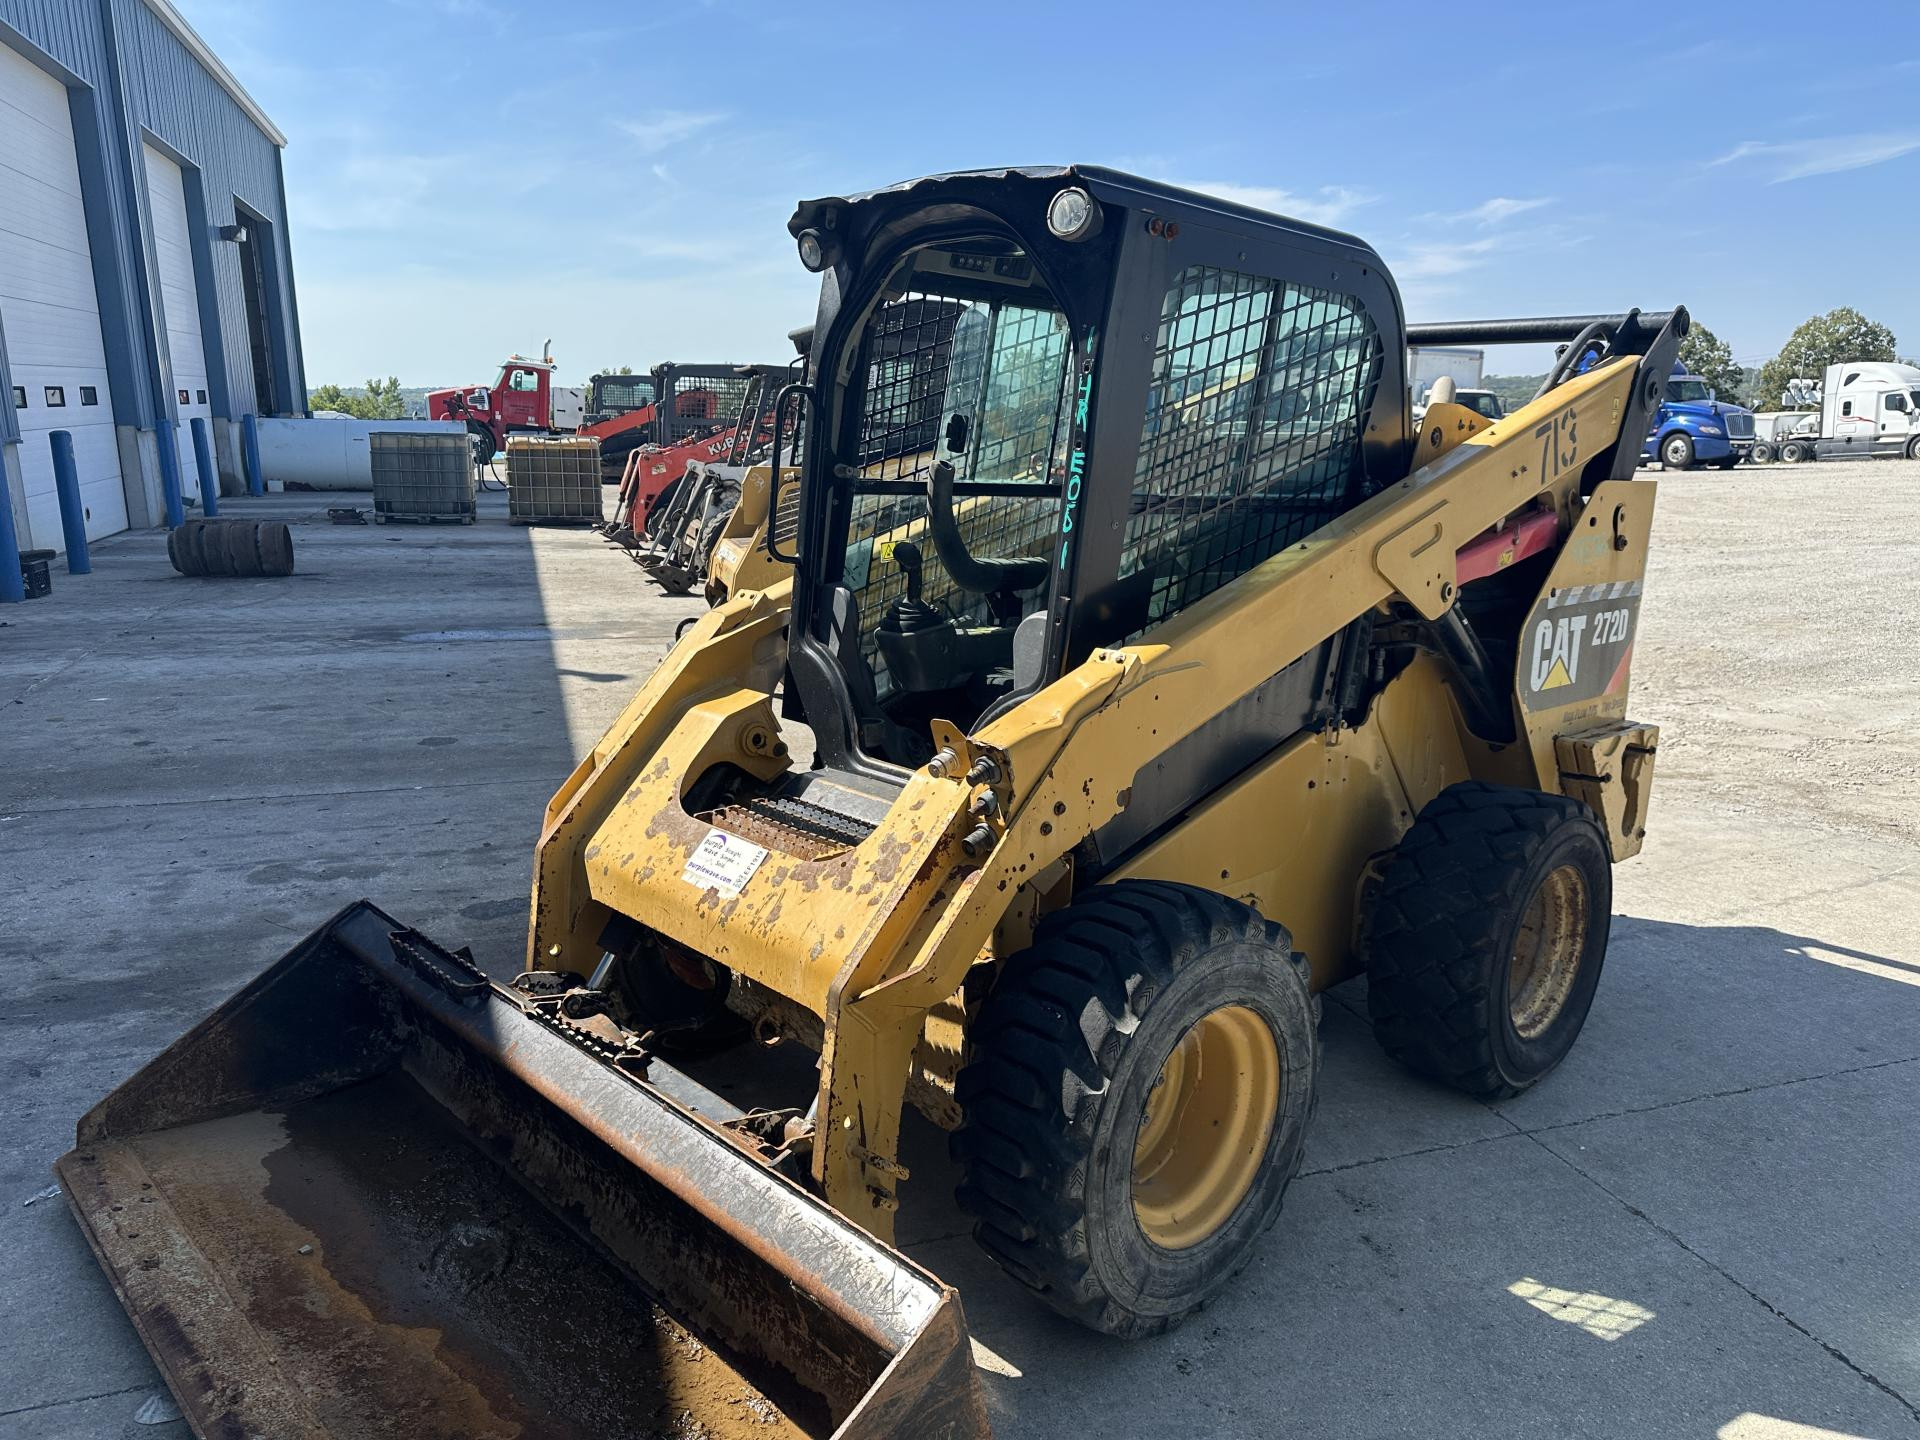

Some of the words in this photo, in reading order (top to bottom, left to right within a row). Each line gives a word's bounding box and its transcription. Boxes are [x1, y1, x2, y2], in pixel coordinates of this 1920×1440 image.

[1535, 407, 1577, 485] 713
[1530, 615, 1587, 692] CAT
[1591, 608, 1629, 646] 272D
[703, 847, 718, 857] wave
[704, 838, 723, 849] purple
[687, 861, 732, 884] purplewave.com
